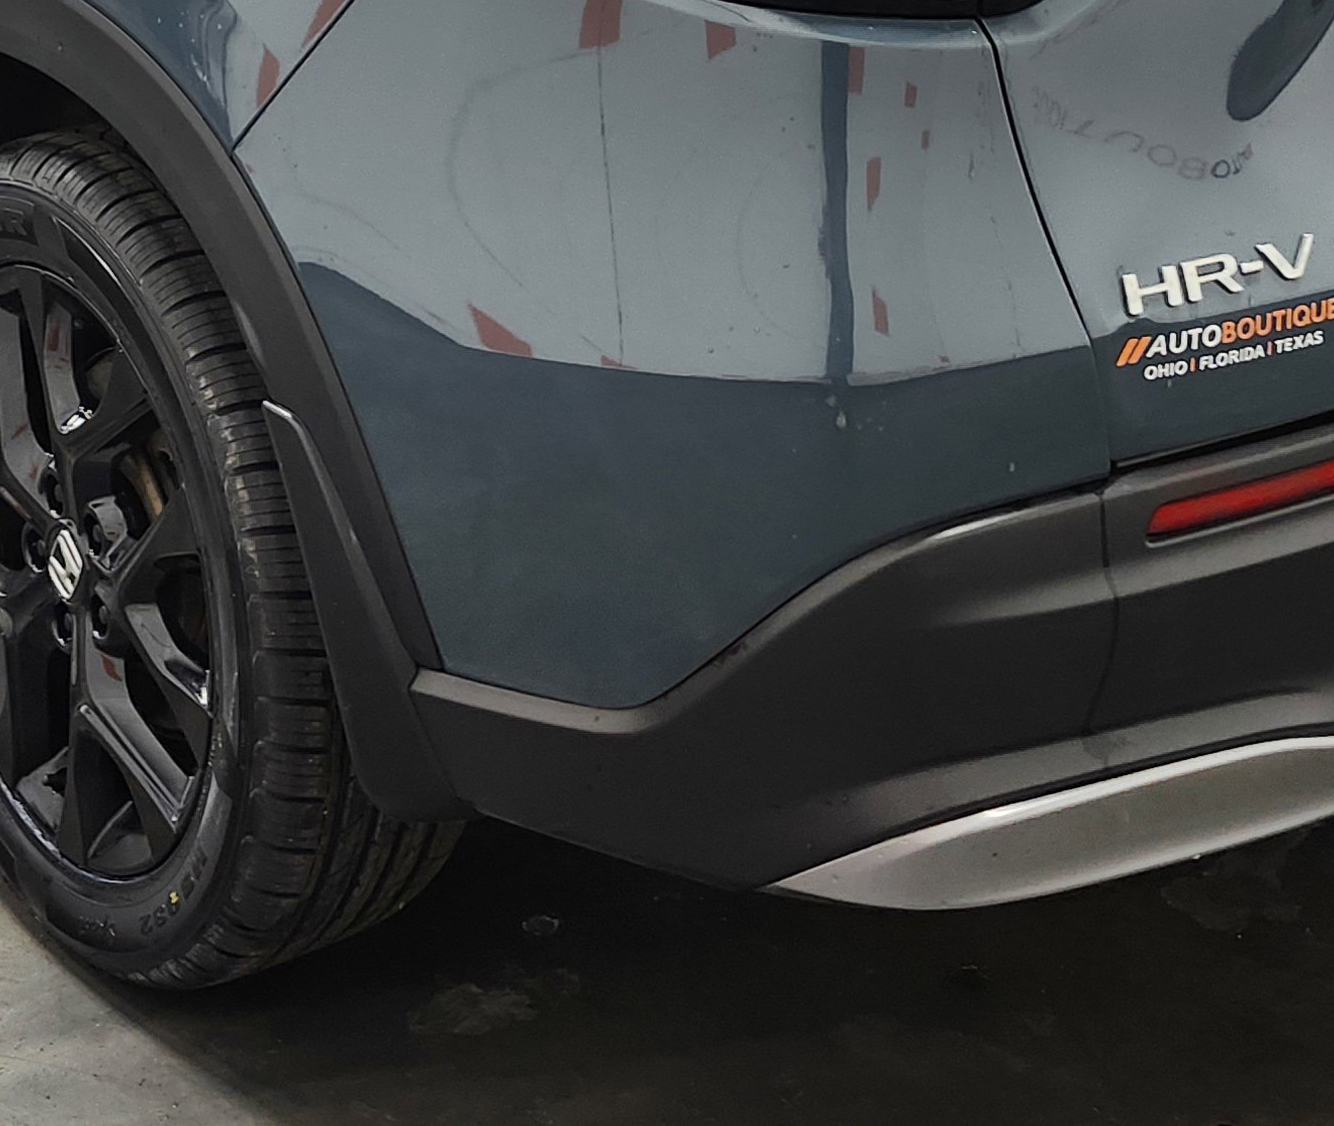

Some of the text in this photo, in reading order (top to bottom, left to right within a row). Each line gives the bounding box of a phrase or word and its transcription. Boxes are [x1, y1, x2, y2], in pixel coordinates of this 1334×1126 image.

[1121, 232, 1315, 317] HR-V
[1143, 329, 1325, 382] OHIO FLORIDA TEXAS
